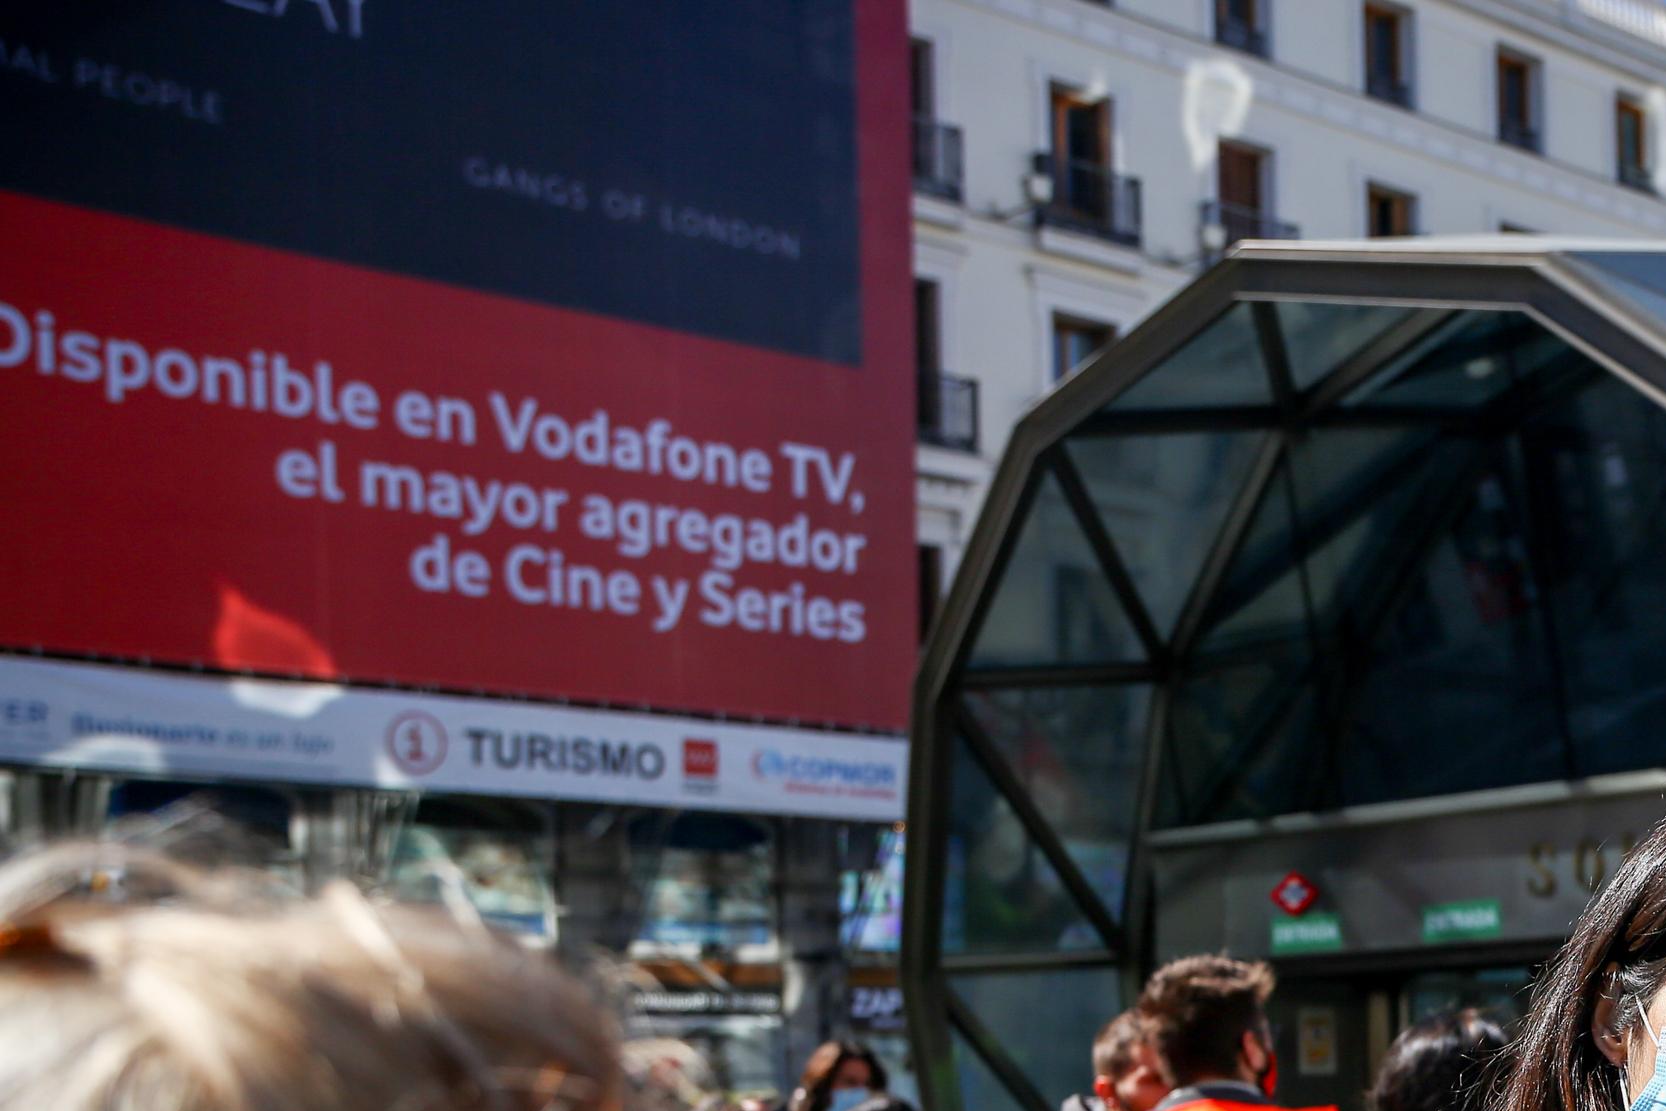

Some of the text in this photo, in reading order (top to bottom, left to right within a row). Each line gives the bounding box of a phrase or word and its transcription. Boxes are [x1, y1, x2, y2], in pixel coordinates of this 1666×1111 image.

[75, 58, 223, 125] PEOPLE
[462, 156, 589, 212] GANGS
[660, 204, 800, 260] LONDON
[395, 391, 477, 446] en
[489, 391, 772, 493] Vodafone
[781, 441, 866, 514] TV,
[275, 440, 868, 575] el mayor agregador
[409, 533, 867, 643] de Cine y Series
[463, 726, 666, 781] TURISMO
